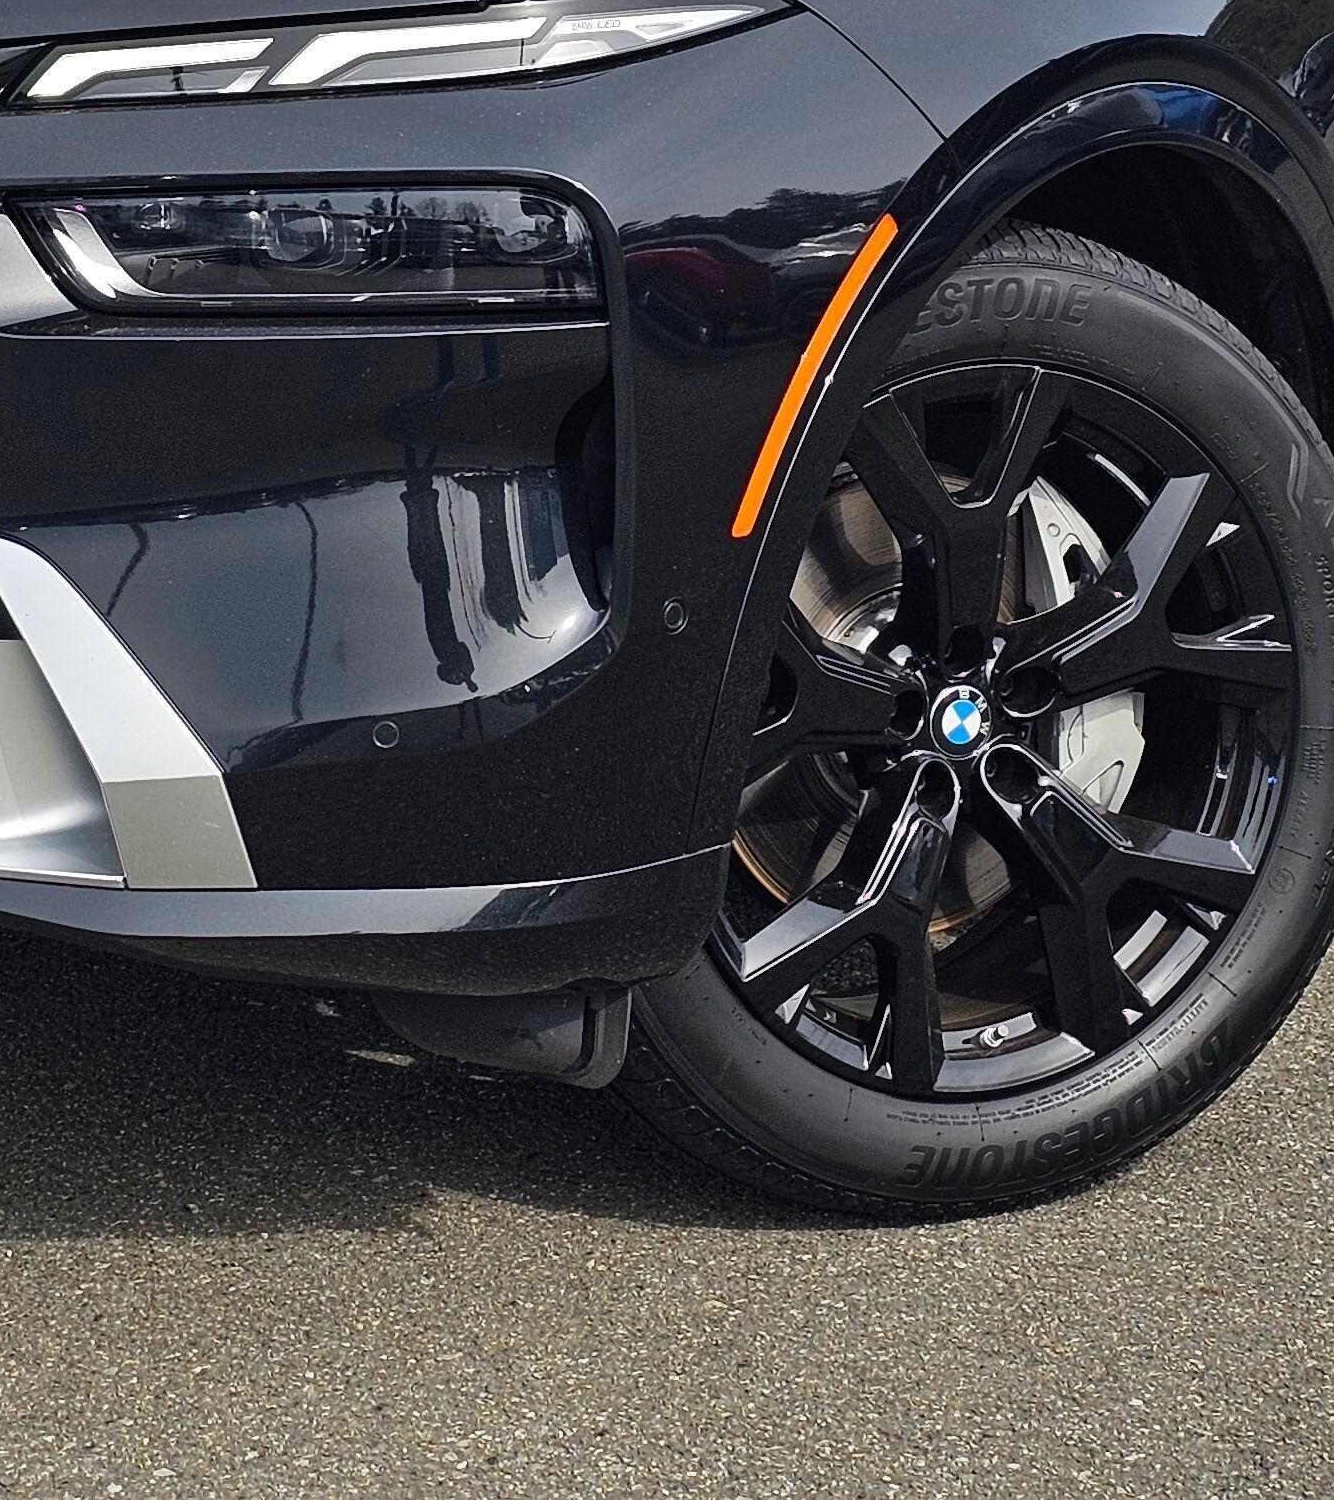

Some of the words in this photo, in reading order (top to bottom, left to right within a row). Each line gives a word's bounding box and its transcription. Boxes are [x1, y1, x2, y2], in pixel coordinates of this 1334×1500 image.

[596, 19, 621, 29] LED
[958, 688, 992, 737] BMW
[893, 1014, 1237, 1191] BRIDGESTONE
